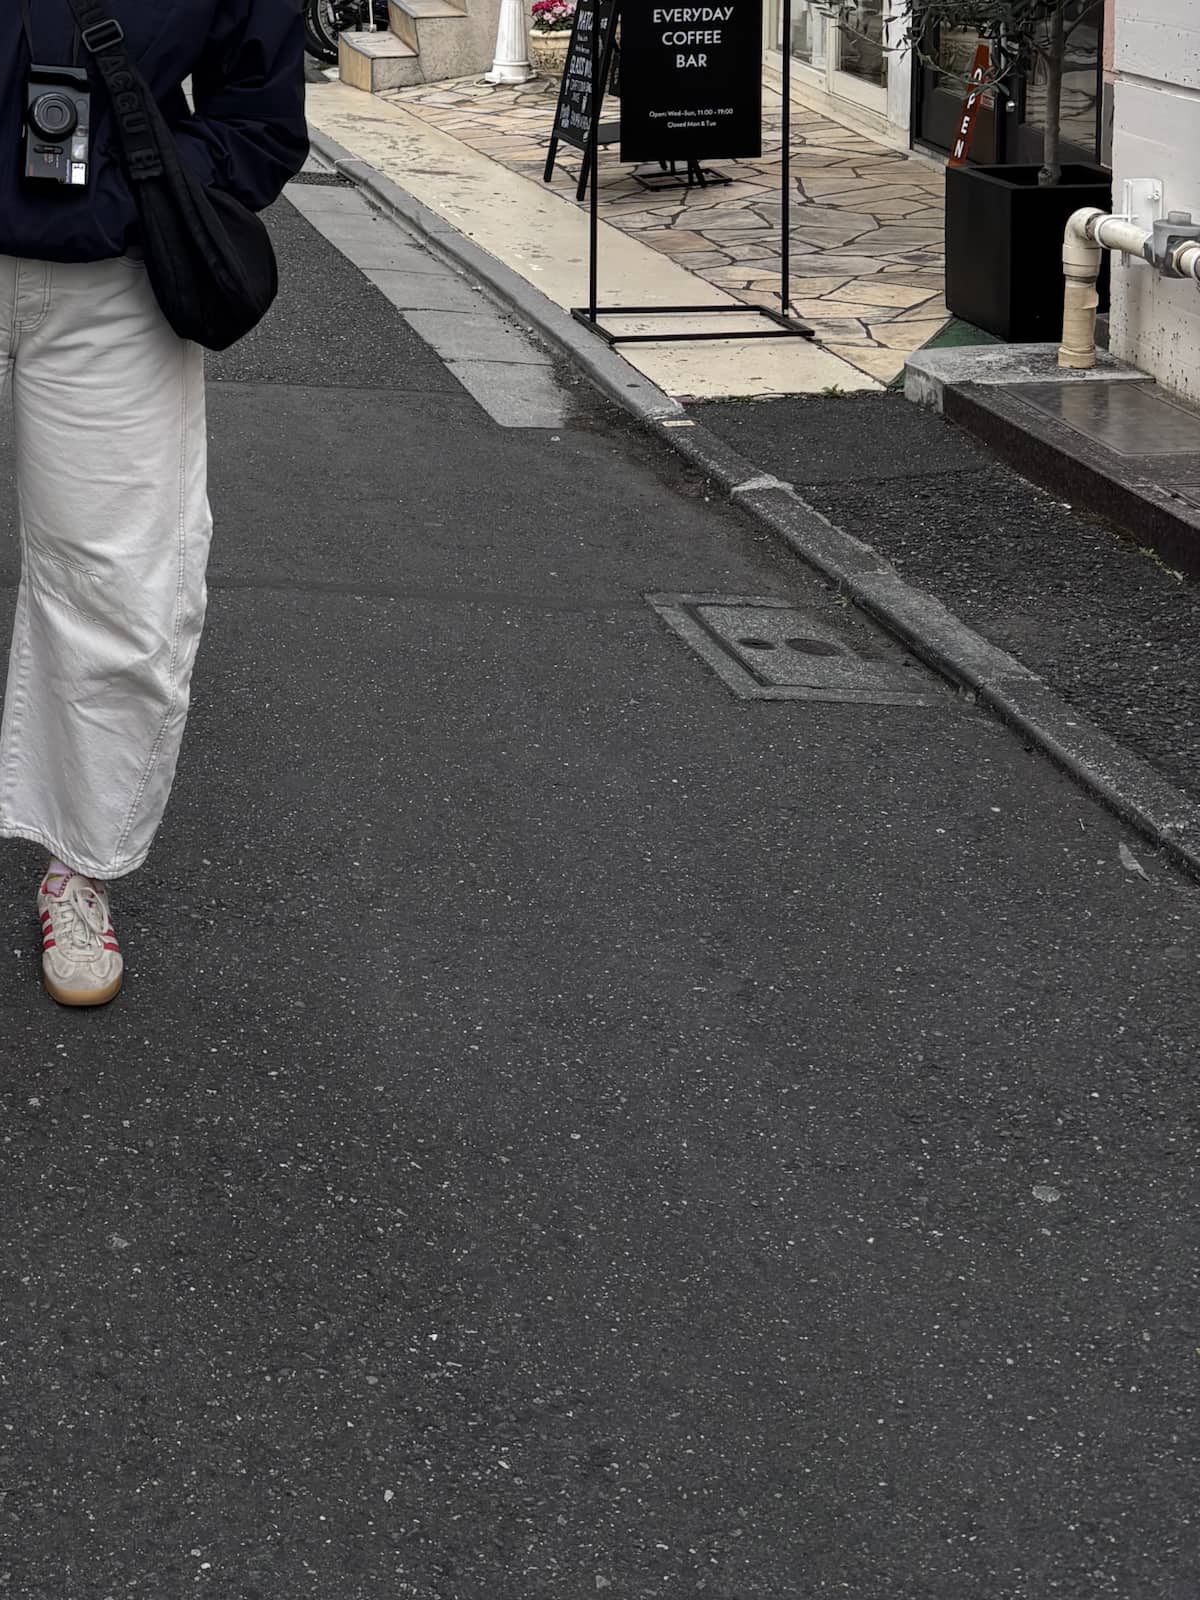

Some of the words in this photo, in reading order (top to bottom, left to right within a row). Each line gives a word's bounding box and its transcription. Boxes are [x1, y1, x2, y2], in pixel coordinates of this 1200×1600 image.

[653, 7, 734, 24] EVERYDAY
[662, 30, 722, 46] COFFEE
[676, 54, 707, 68] BAR
[954, 68, 982, 159] OPEN
[667, 121, 686, 129] Closed
